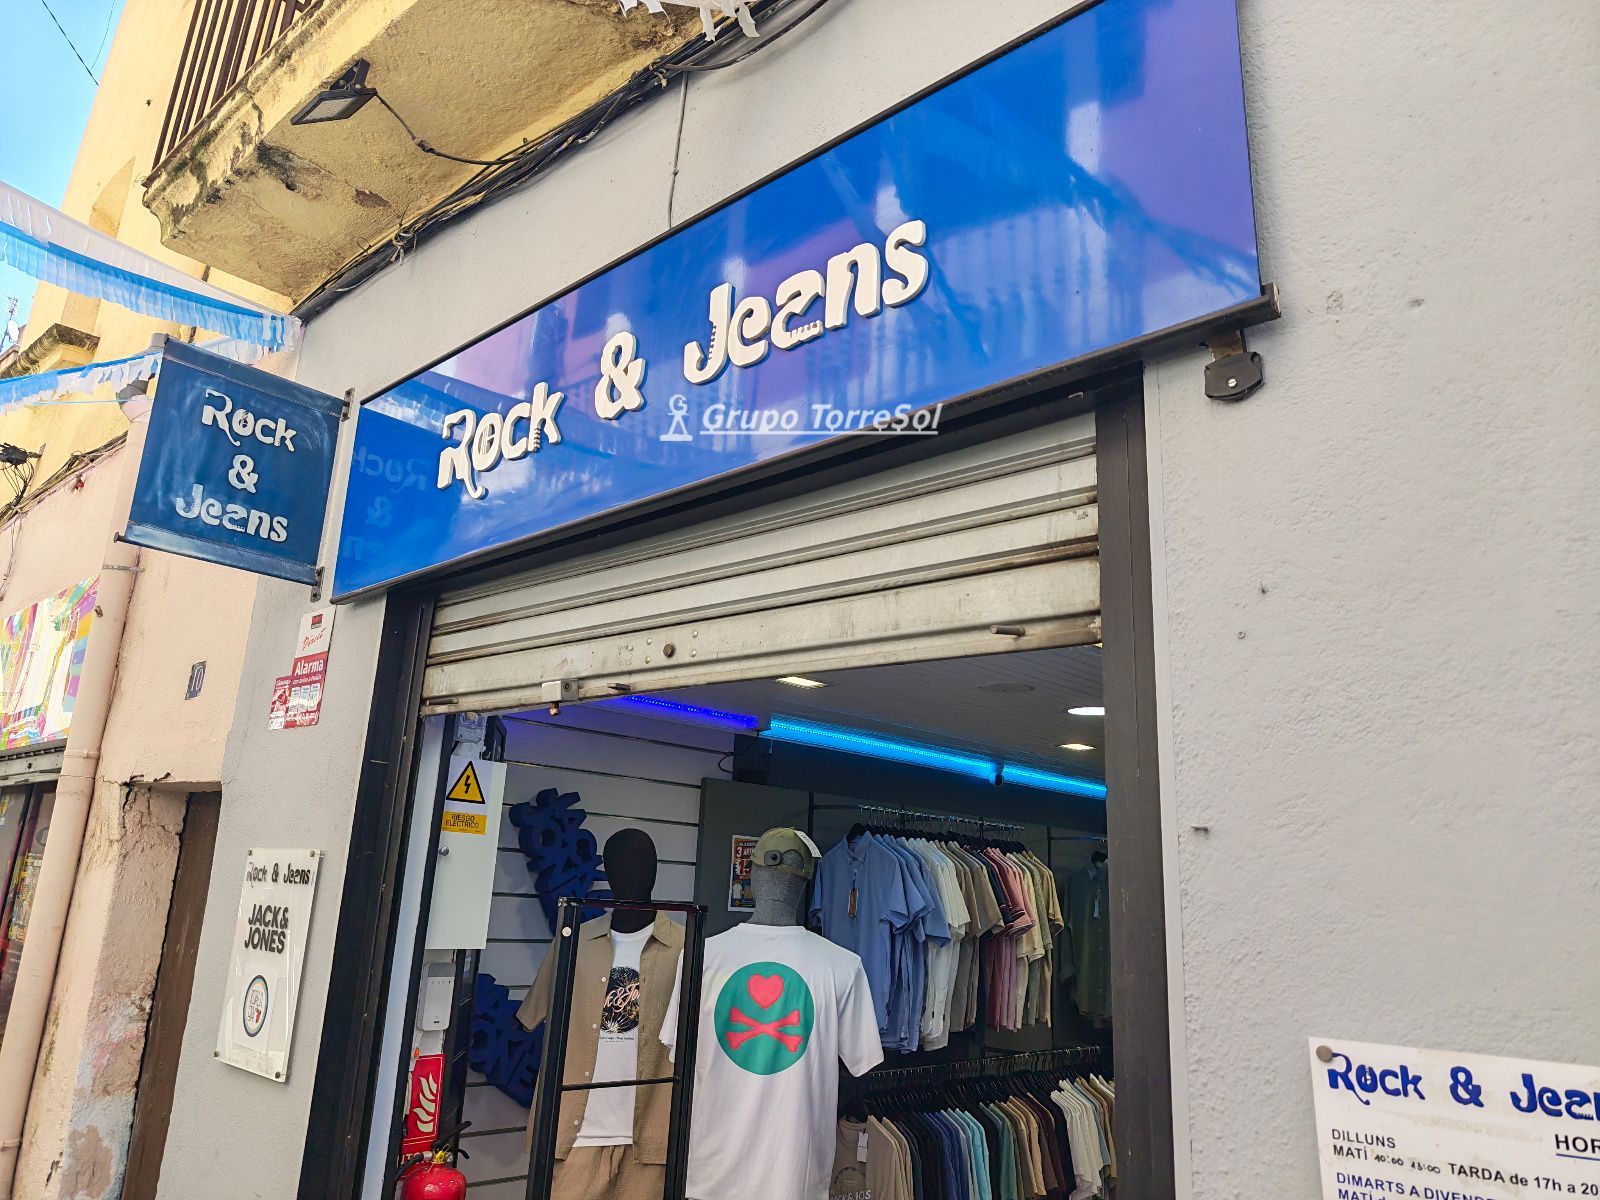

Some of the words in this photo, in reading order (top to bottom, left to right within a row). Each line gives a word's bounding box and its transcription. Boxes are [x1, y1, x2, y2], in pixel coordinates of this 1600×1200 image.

[437, 382, 564, 499] Rock
[594, 331, 646, 419] &
[683, 219, 929, 384] Jeans
[201, 389, 298, 452] Rock
[228, 454, 258, 494] &
[175, 484, 288, 542] Jeans
[294, 660, 323, 676] Alarma
[451, 814, 475, 822] RIESGO
[246, 862, 267, 888] Rock
[271, 862, 279, 883] &
[283, 863, 311, 885] Jeans
[244, 927, 286, 954] JONES
[1327, 1052, 1425, 1106] Rock
[1449, 1065, 1485, 1108] &
[1331, 1128, 1396, 1149] DILLUNS
[1336, 1172, 1405, 1194] DIMARTS
[1409, 1185, 1420, 1198] A
[1448, 1162, 1506, 1184] TARDA
[1509, 1173, 1528, 1186] de
[1534, 1176, 1562, 1191] 17h
[1567, 1183, 1576, 1193] a
